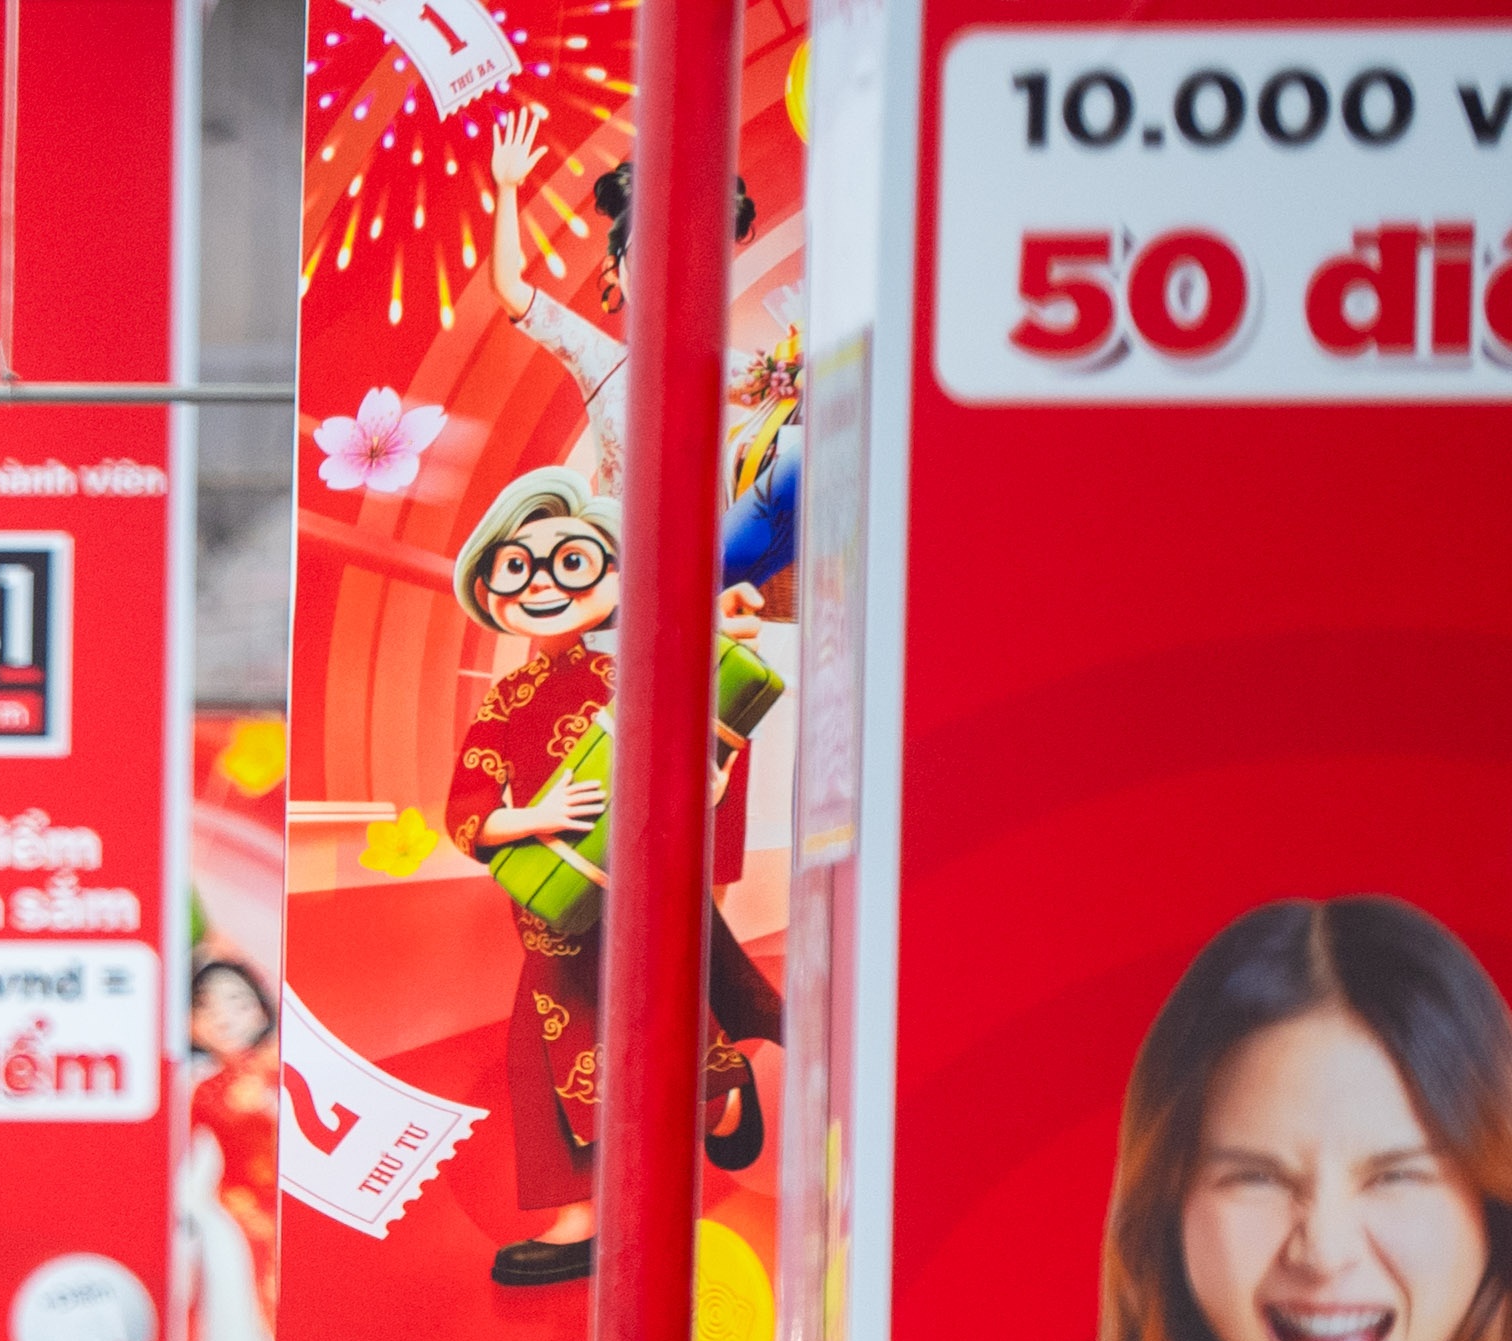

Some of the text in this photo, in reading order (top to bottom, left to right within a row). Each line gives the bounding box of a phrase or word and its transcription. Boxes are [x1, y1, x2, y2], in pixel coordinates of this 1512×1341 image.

[419, 3, 467, 55] 1
[1014, 65, 1416, 152] 10.000
[1008, 217, 1512, 368] 50 đi
[9, 866, 141, 933] sắm
